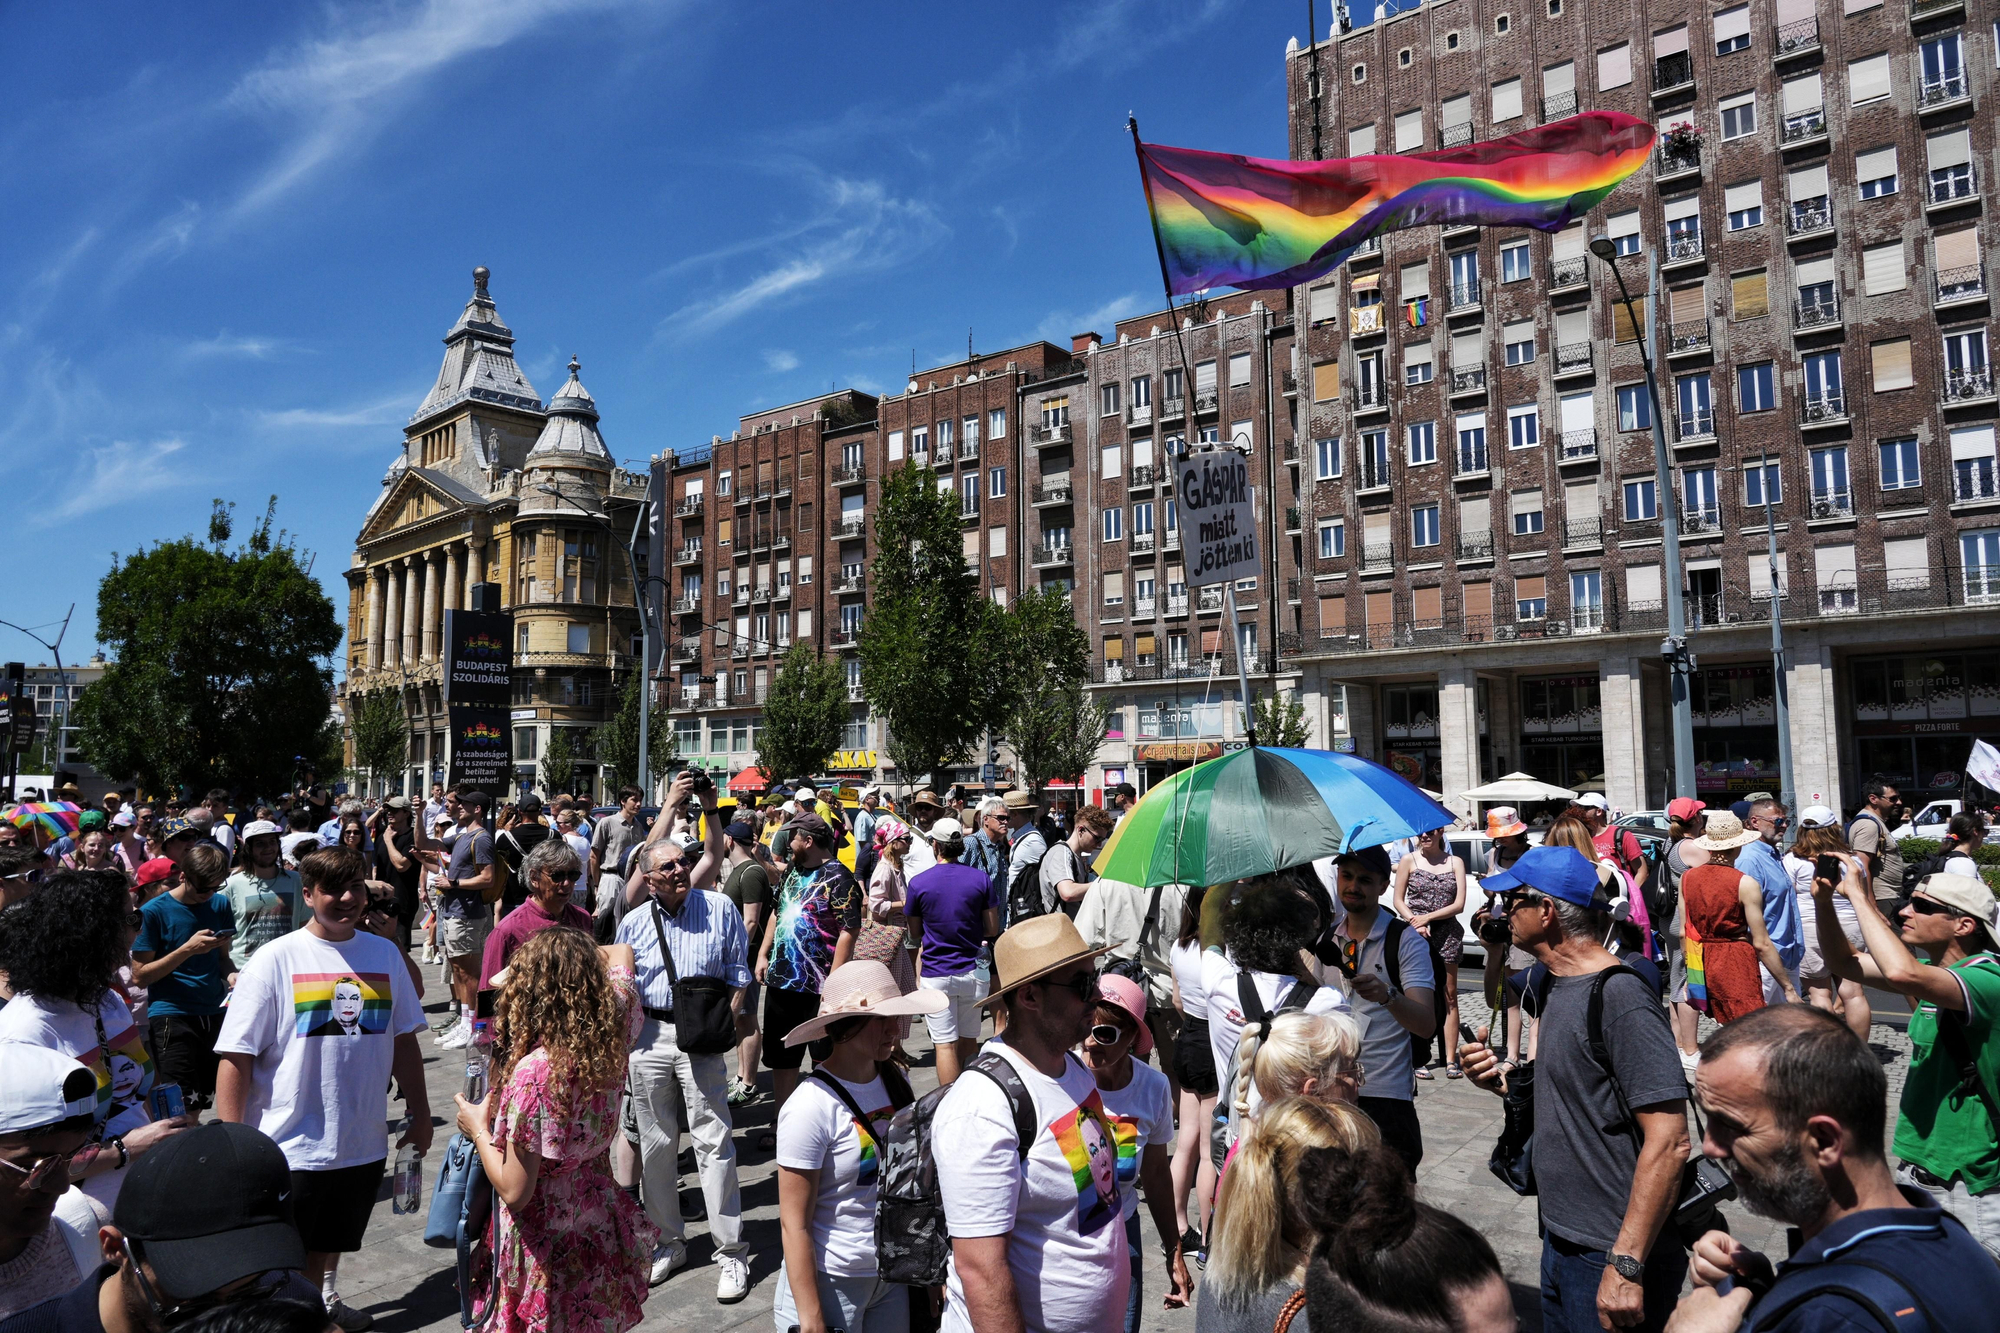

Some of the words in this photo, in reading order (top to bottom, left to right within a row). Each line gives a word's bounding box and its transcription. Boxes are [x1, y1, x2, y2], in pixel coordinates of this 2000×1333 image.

[1183, 457, 1248, 511] GÁSPÁR
[1199, 508, 1238, 544] miatt
[456, 660, 508, 672] BUDAPEST
[452, 672, 510, 685] SZOLIDÁRIS
[1893, 675, 1960, 688] madenta
[1914, 724, 1936, 732] PIZZA
[1937, 722, 1960, 731] FORTE
[462, 750, 508, 759] szabadságot
[1146, 743, 1207, 756] creativenailshu
[455, 759, 464, 767] és
[471, 759, 508, 767] szerelmet
[465, 768, 497, 776] betiltani
[477, 776, 500, 784] lehet!
